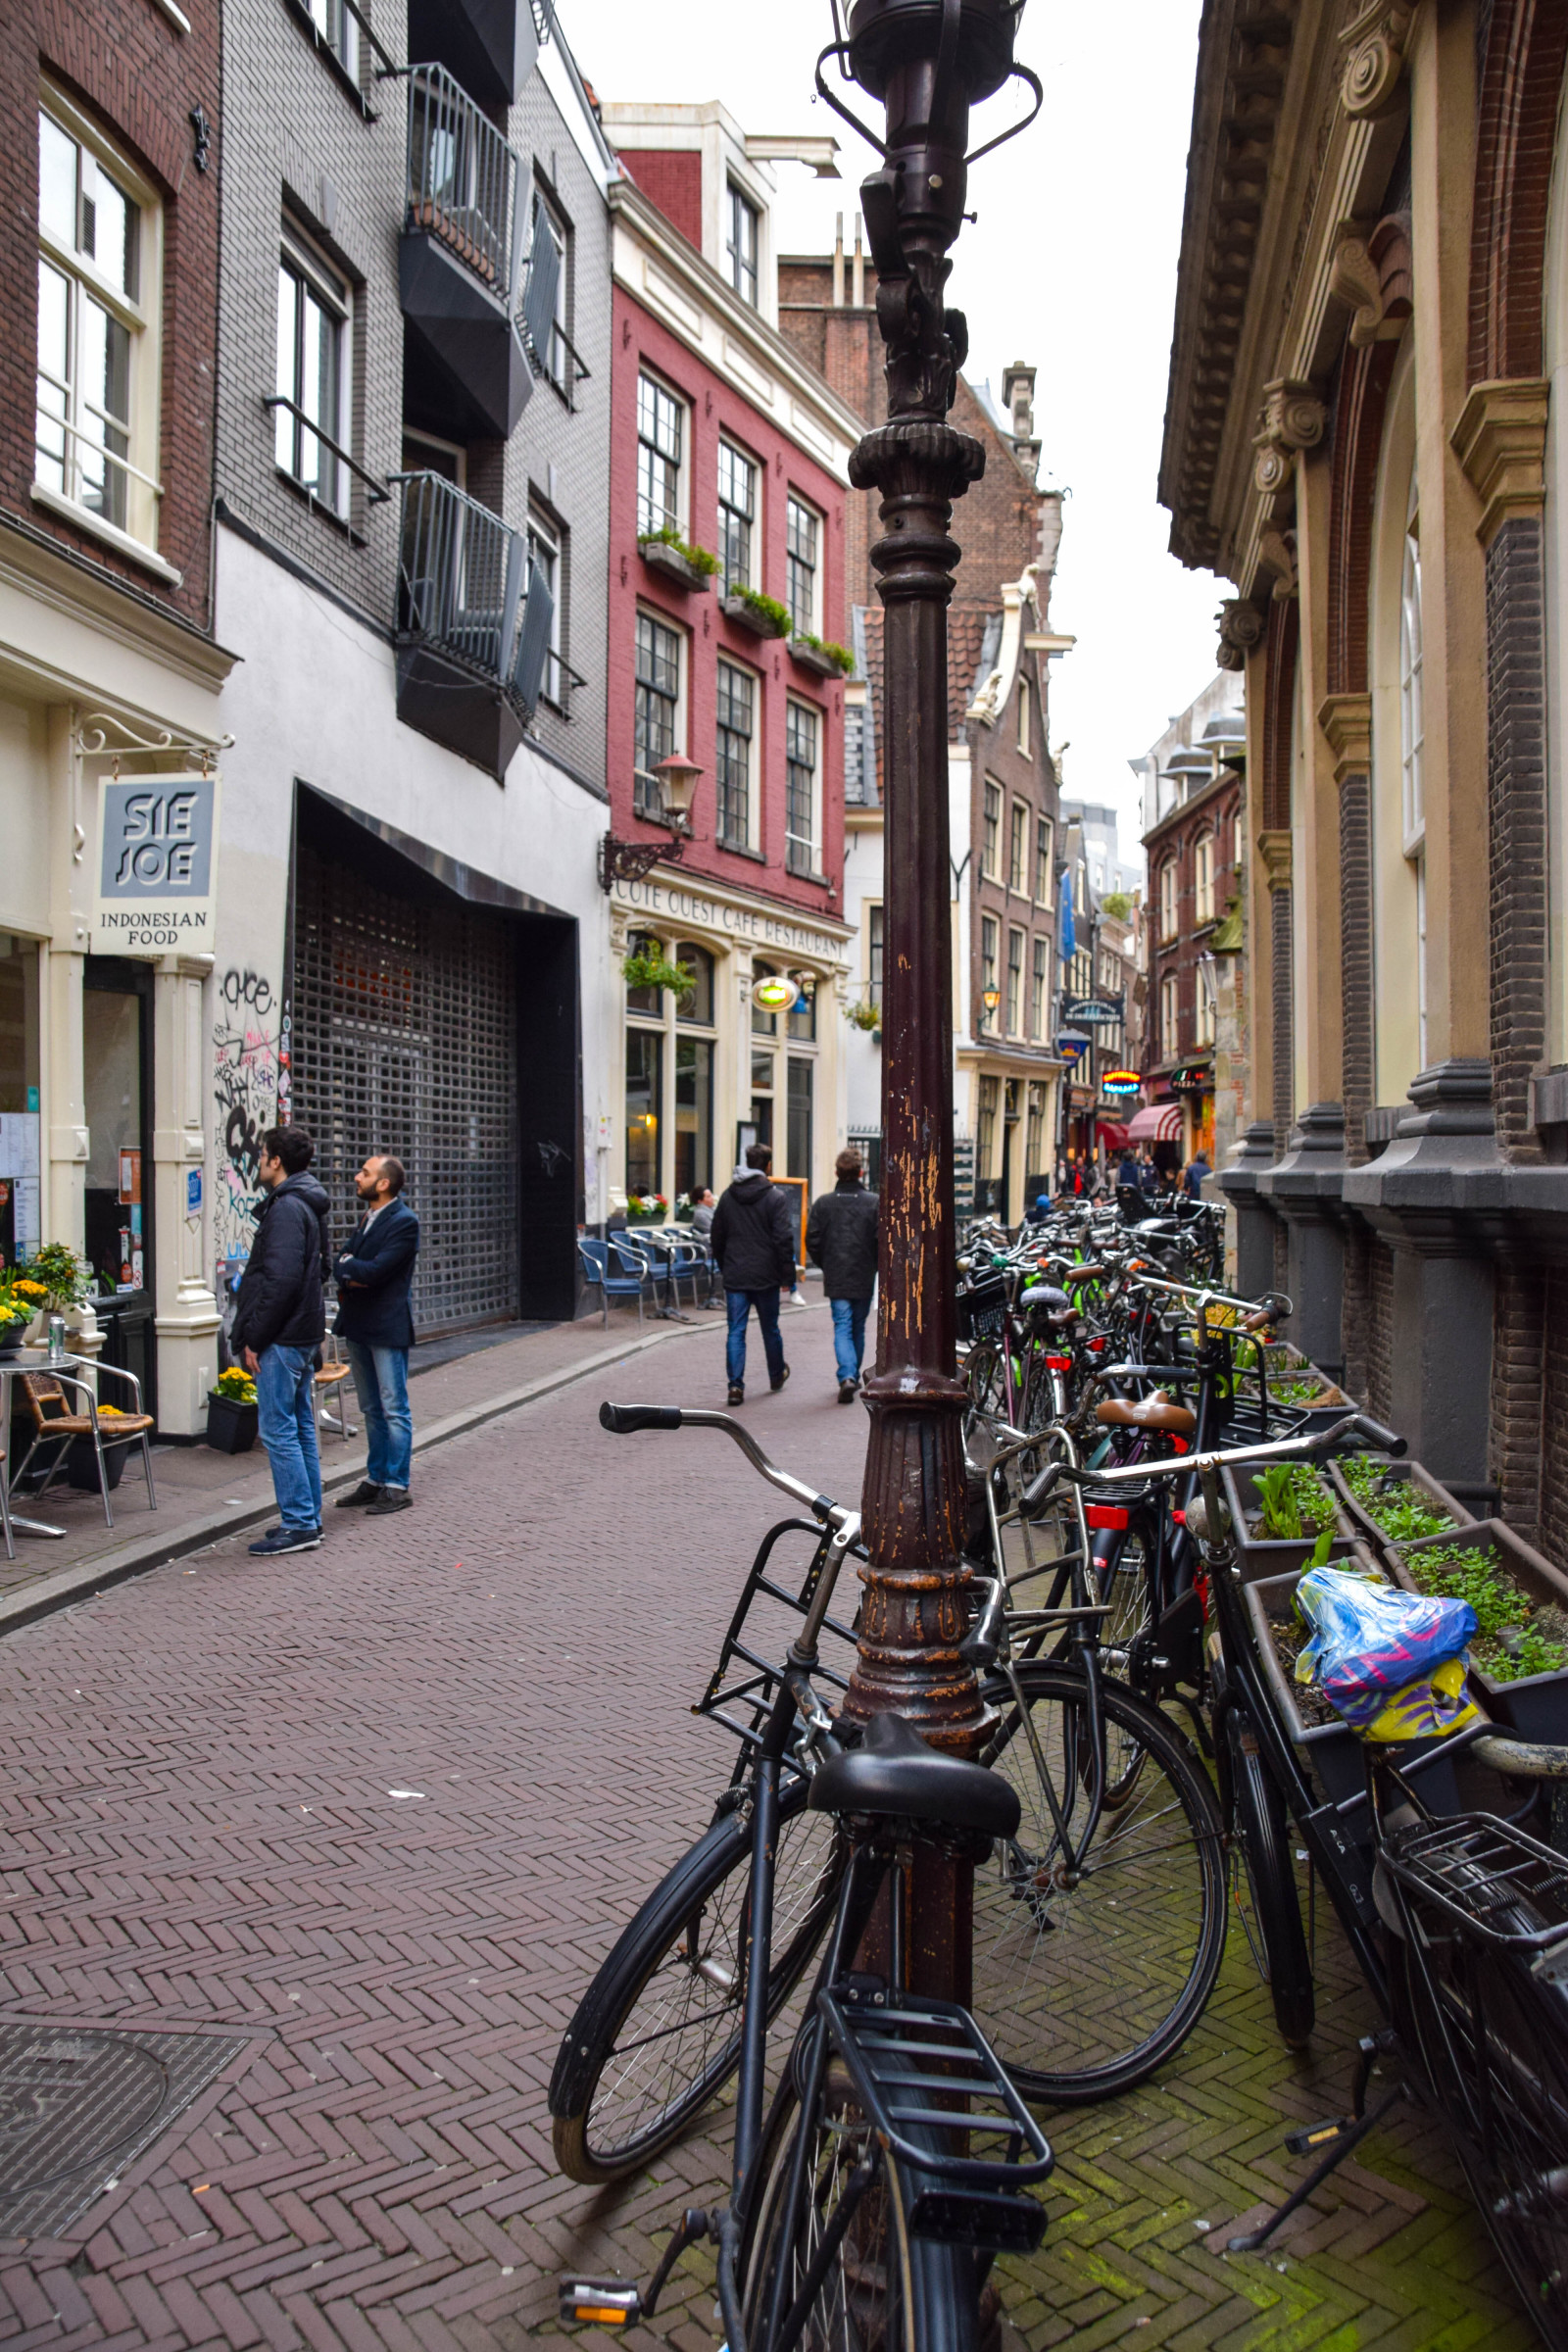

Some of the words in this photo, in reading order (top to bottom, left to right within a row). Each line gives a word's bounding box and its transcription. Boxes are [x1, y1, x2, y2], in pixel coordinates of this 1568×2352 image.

[123, 791, 198, 840] SIE
[116, 842, 198, 885] JOE
[101, 911, 207, 927] INDONESIAN
[668, 890, 716, 924] OUEST
[127, 930, 177, 945] FOOD
